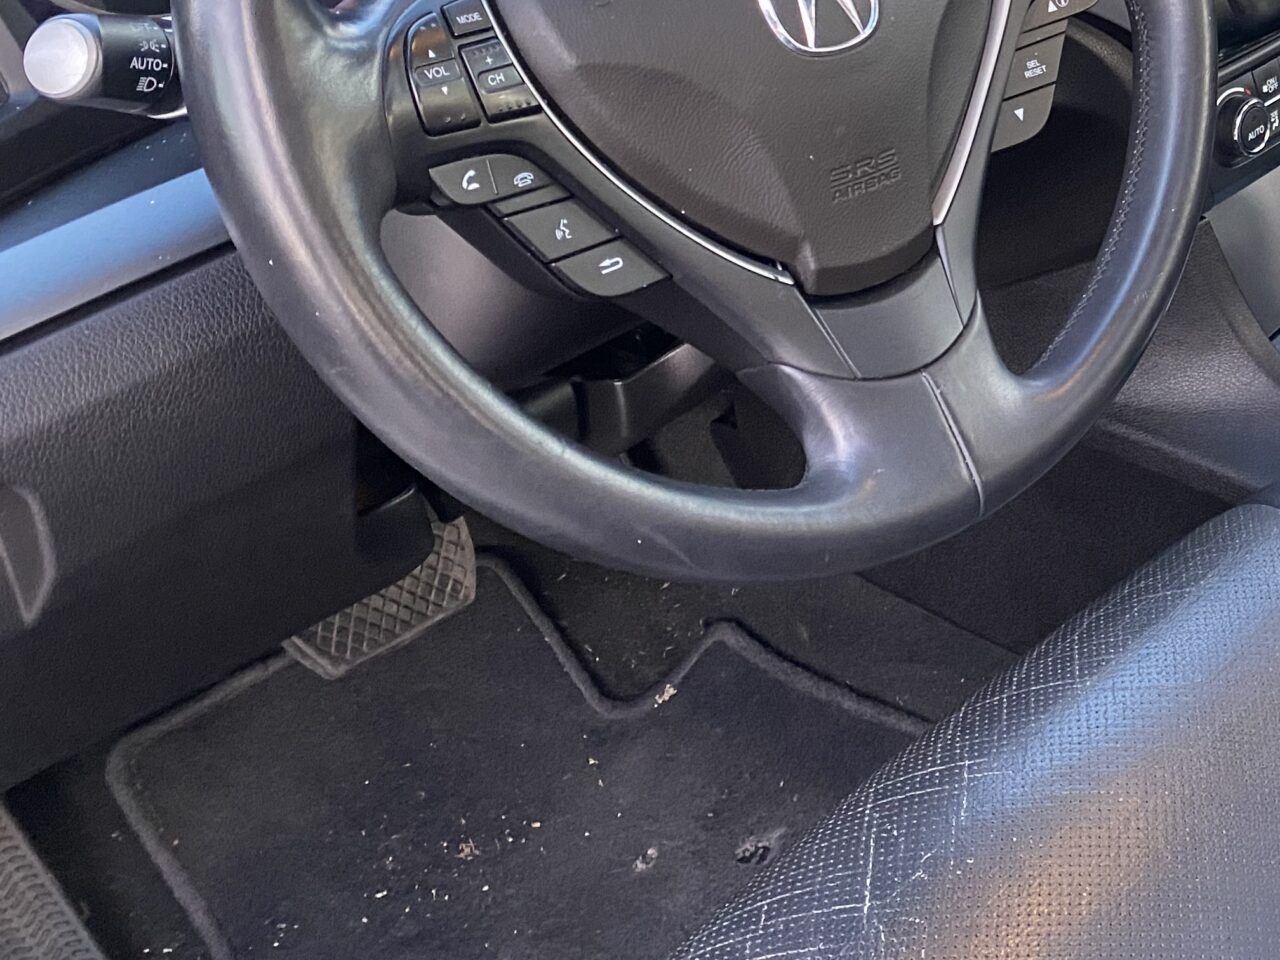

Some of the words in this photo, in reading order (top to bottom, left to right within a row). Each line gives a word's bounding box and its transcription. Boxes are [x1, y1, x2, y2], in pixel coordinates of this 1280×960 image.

[455, 12, 483, 25] MODE
[129, 56, 162, 71] AUTO
[1026, 60, 1041, 69] SEL
[424, 66, 450, 79] VOL
[1024, 65, 1046, 79] RESET
[487, 73, 505, 86] CH
[1248, 124, 1265, 141] AUTO
[829, 148, 899, 184] SRS
[832, 168, 902, 205] AIRBAG
